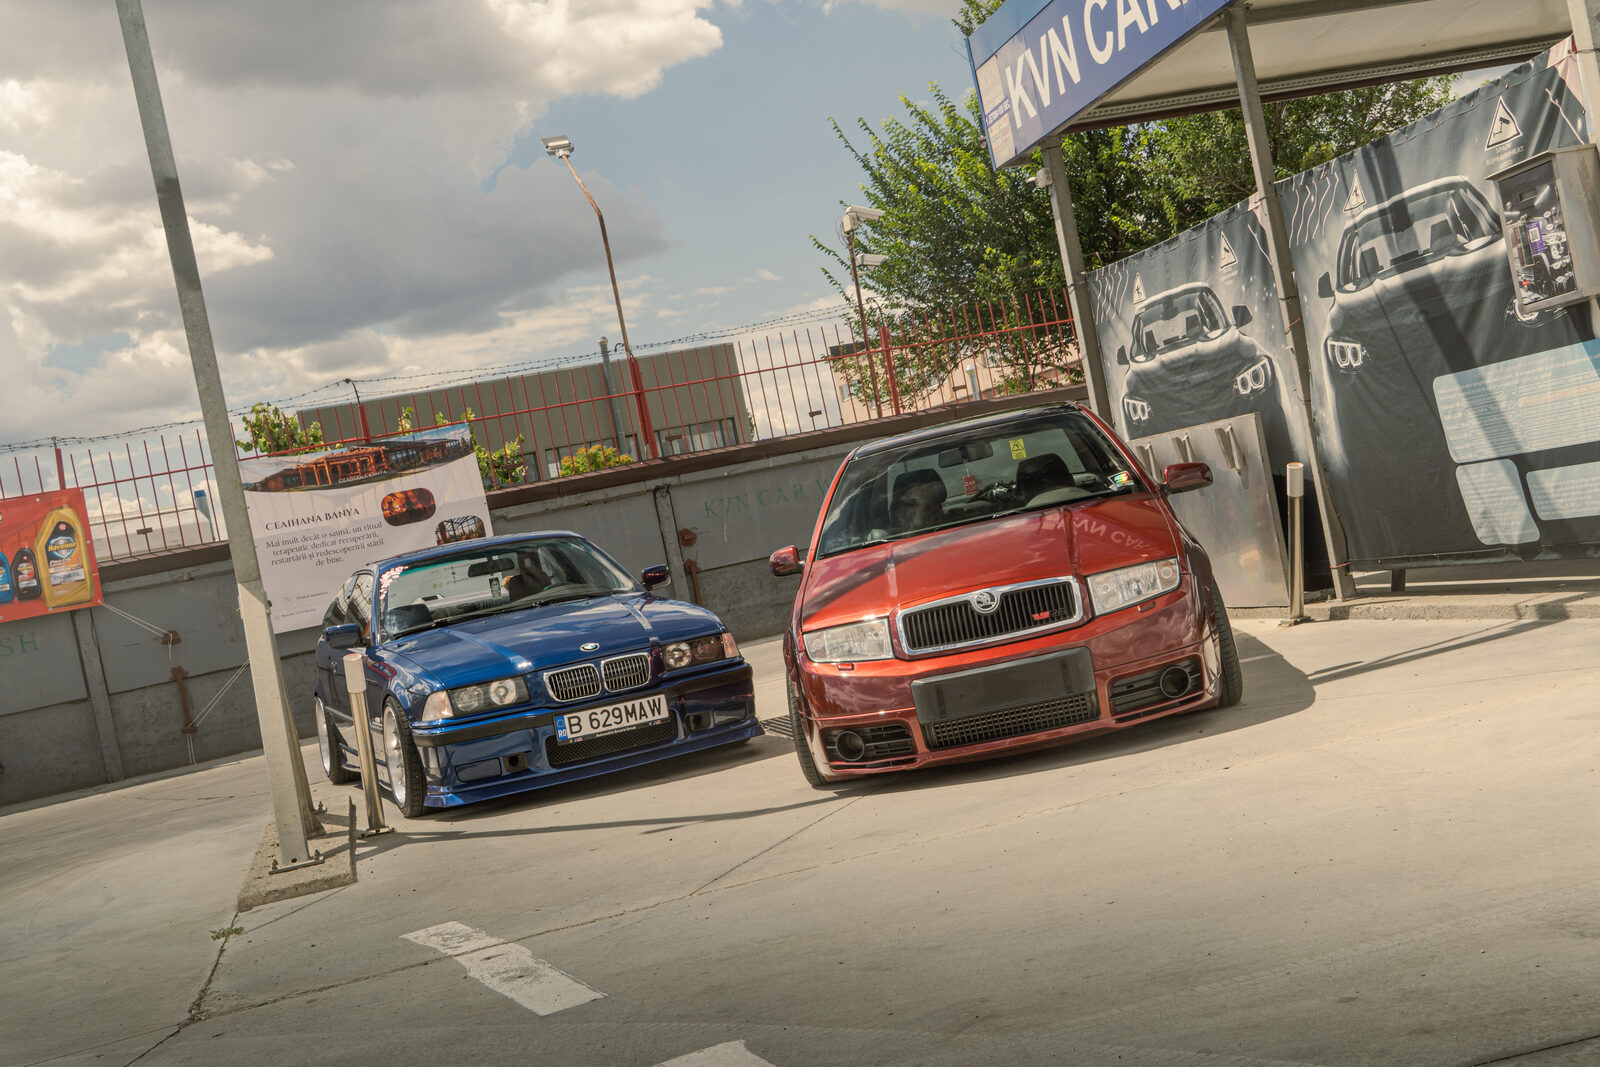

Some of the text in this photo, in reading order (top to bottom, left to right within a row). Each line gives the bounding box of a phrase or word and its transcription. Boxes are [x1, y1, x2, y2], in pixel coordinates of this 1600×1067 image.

[1005, 14, 1081, 130] KVN
[704, 493, 750, 518] KVN
[758, 483, 804, 506] CAR
[265, 507, 360, 530] CEAIHANA BANYA
[266, 541, 281, 549] Mai
[282, 537, 299, 546] mult
[352, 526, 362, 534] un
[363, 521, 383, 531] ritual
[272, 543, 309, 556] terapeutic
[311, 539, 337, 550] dedicat
[316, 543, 366, 558] redescoperirii
[315, 555, 345, 567] de bine.
[567, 697, 662, 735] B 629MAW
[558, 729, 567, 738] RO
